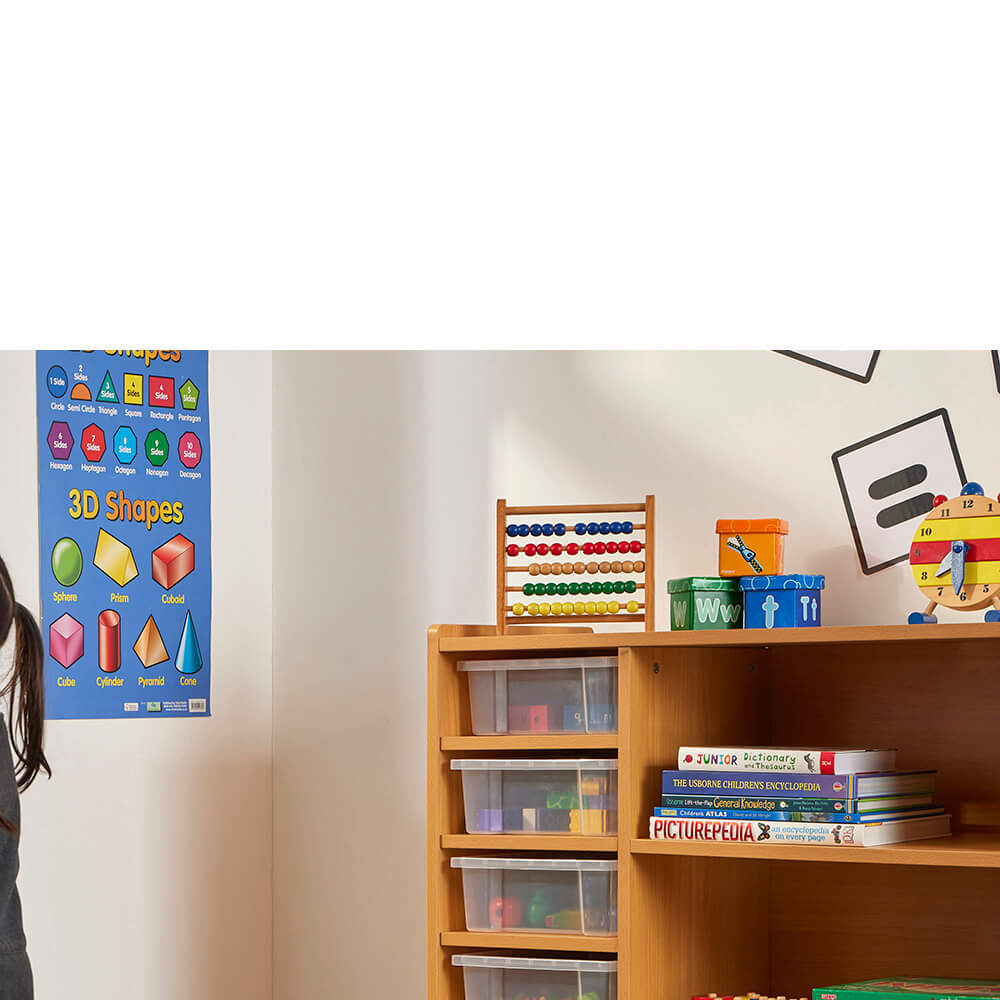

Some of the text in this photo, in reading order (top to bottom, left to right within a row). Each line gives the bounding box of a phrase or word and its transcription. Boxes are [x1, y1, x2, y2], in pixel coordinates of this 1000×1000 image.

[78, 364, 83, 372] 2
[49, 377, 65, 386] 1 Side
[73, 372, 88, 382] Sides
[100, 390, 115, 399] Sides
[126, 388, 140, 398] Sides
[154, 391, 168, 400] Sides
[183, 394, 196, 402] Sides
[50, 401, 65, 411] Circle
[67, 403, 95, 414] Semi Circle
[97, 405, 118, 416] Triangle
[124, 408, 142, 418] Square
[149, 410, 174, 421] Rectangle
[178, 413, 201, 424] Pentagon
[58, 432, 63, 440] 6
[91, 434, 96, 442] 7
[53, 440, 67, 449] Sides
[86, 442, 101, 451] Sides
[154, 439, 159, 447] 9
[187, 441, 193, 450] 10
[118, 445, 132, 454] Sides
[150, 447, 164, 456] Sides
[183, 450, 197, 458] Sides
[49, 461, 73, 471] Hexagon
[81, 463, 106, 474] Heptagon
[114, 465, 136, 476] Octagon
[145, 468, 169, 478] Nonagon
[179, 470, 202, 480] Decagon
[68, 487, 184, 531] 3D Shapes
[962, 500, 974, 509] 12
[987, 503, 993, 512] 1
[941, 508, 951, 517] 11
[920, 527, 932, 537] 10
[915, 549, 921, 558] 9
[920, 571, 928, 580] 8
[937, 586, 944, 597] 7
[982, 583, 990, 593] 5
[53, 591, 78, 603] Sphere
[110, 592, 129, 603] Prism
[161, 594, 185, 604] Cuboid
[959, 592, 967, 601] 6
[695, 598, 741, 623] Ww
[57, 677, 76, 687] Cube
[96, 677, 124, 688] Cylinder
[138, 676, 165, 688] Pyramid
[179, 676, 197, 686] Cone
[696, 752, 796, 765] JUNIOR Dictionary
[755, 762, 796, 770] Thesaurus
[673, 778, 821, 792] THE USBORNE CHILDREN'S ENCYCLOPEDIA
[713, 796, 740, 808] General
[740, 797, 775, 811] Knowledge
[654, 819, 754, 841] PICTUREPEDIA
[782, 824, 830, 834] encyclopedia
[786, 834, 806, 842] every
[808, 834, 826, 842] page
